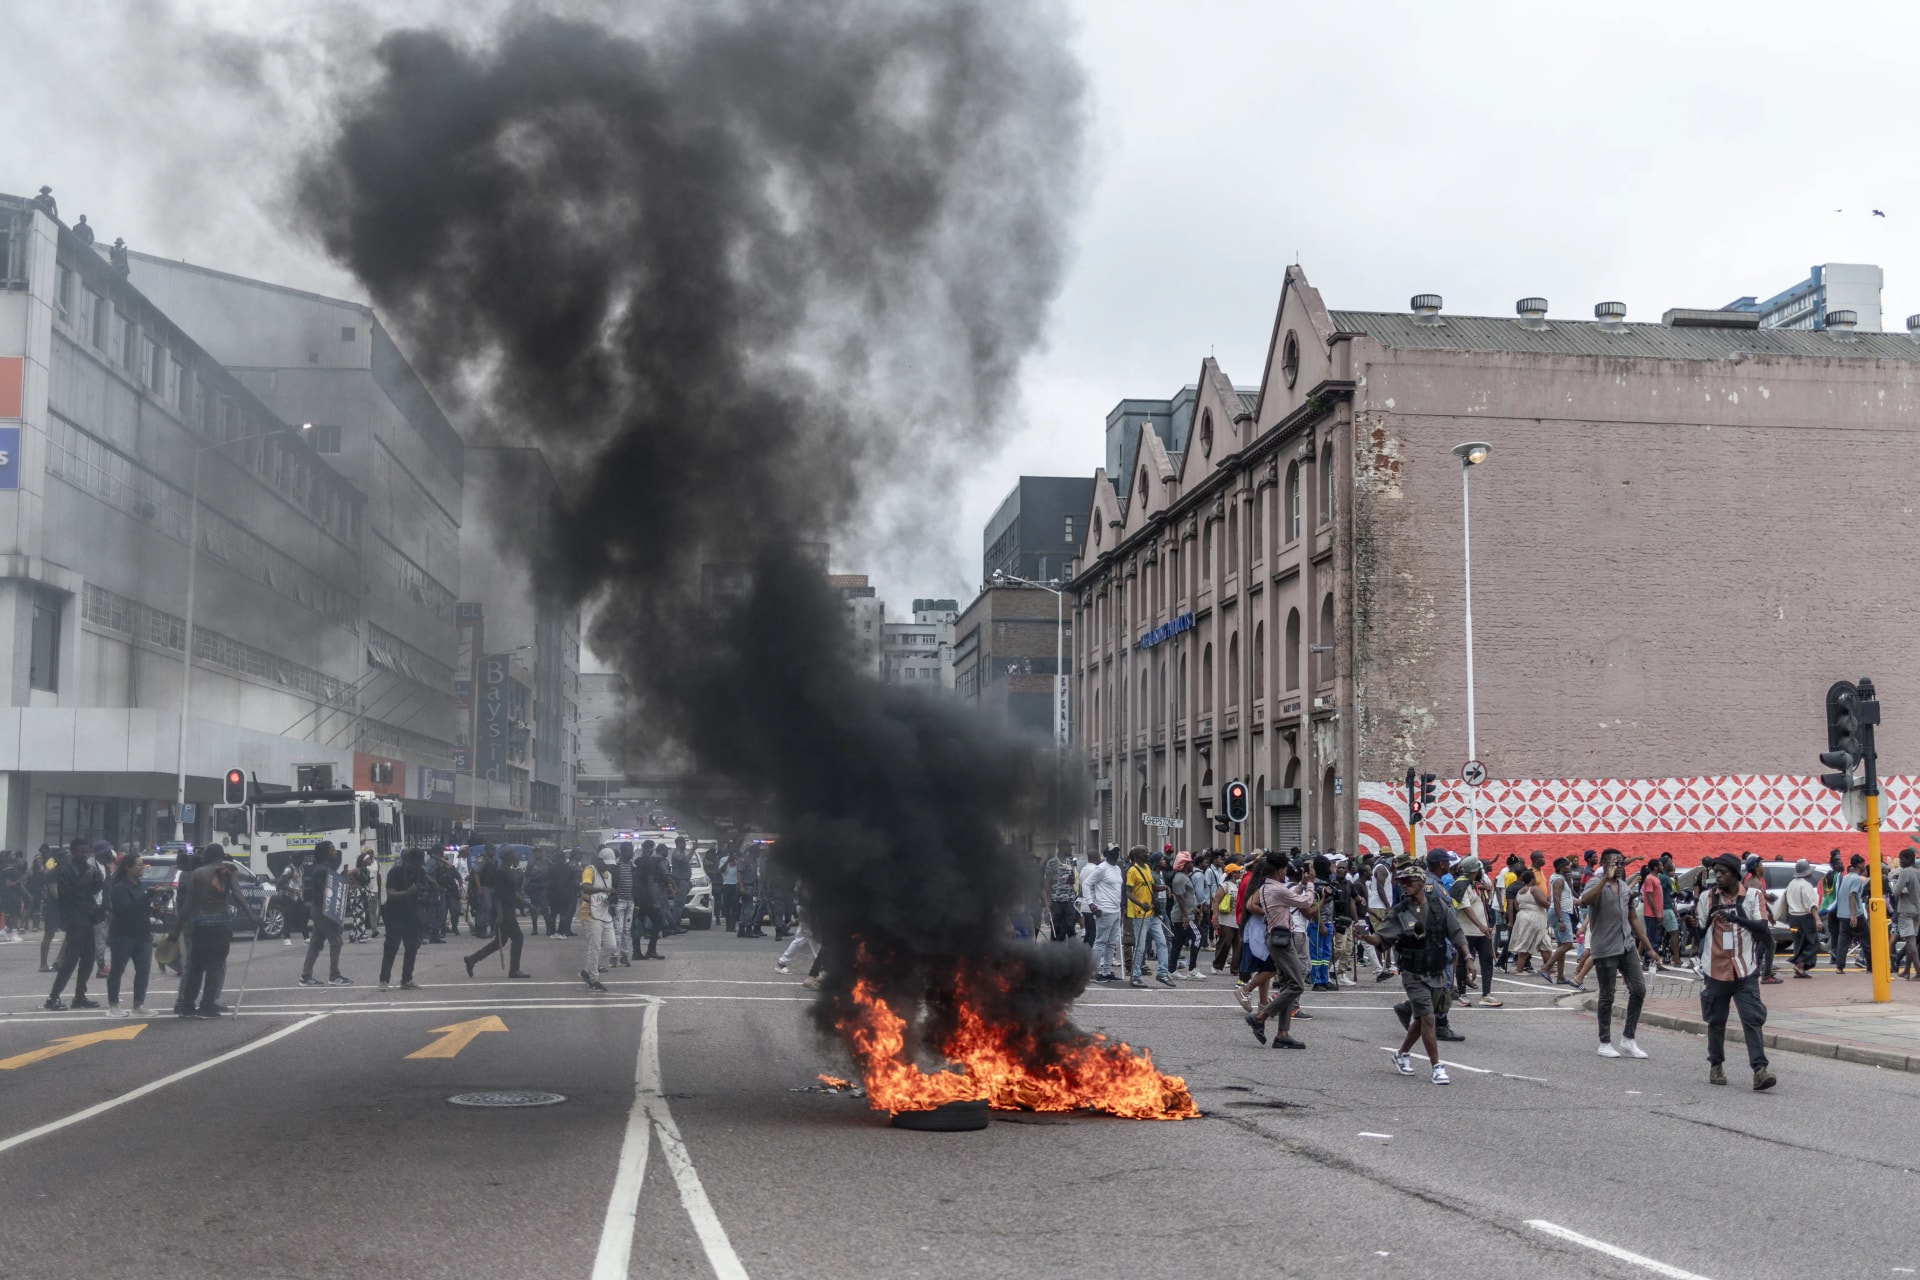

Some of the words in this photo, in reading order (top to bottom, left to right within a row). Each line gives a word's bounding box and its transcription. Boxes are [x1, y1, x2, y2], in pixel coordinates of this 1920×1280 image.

[485, 661, 504, 781] Baysid
[1146, 816, 1176, 827] SHEPSTONE
[1871, 901, 1878, 912] C
